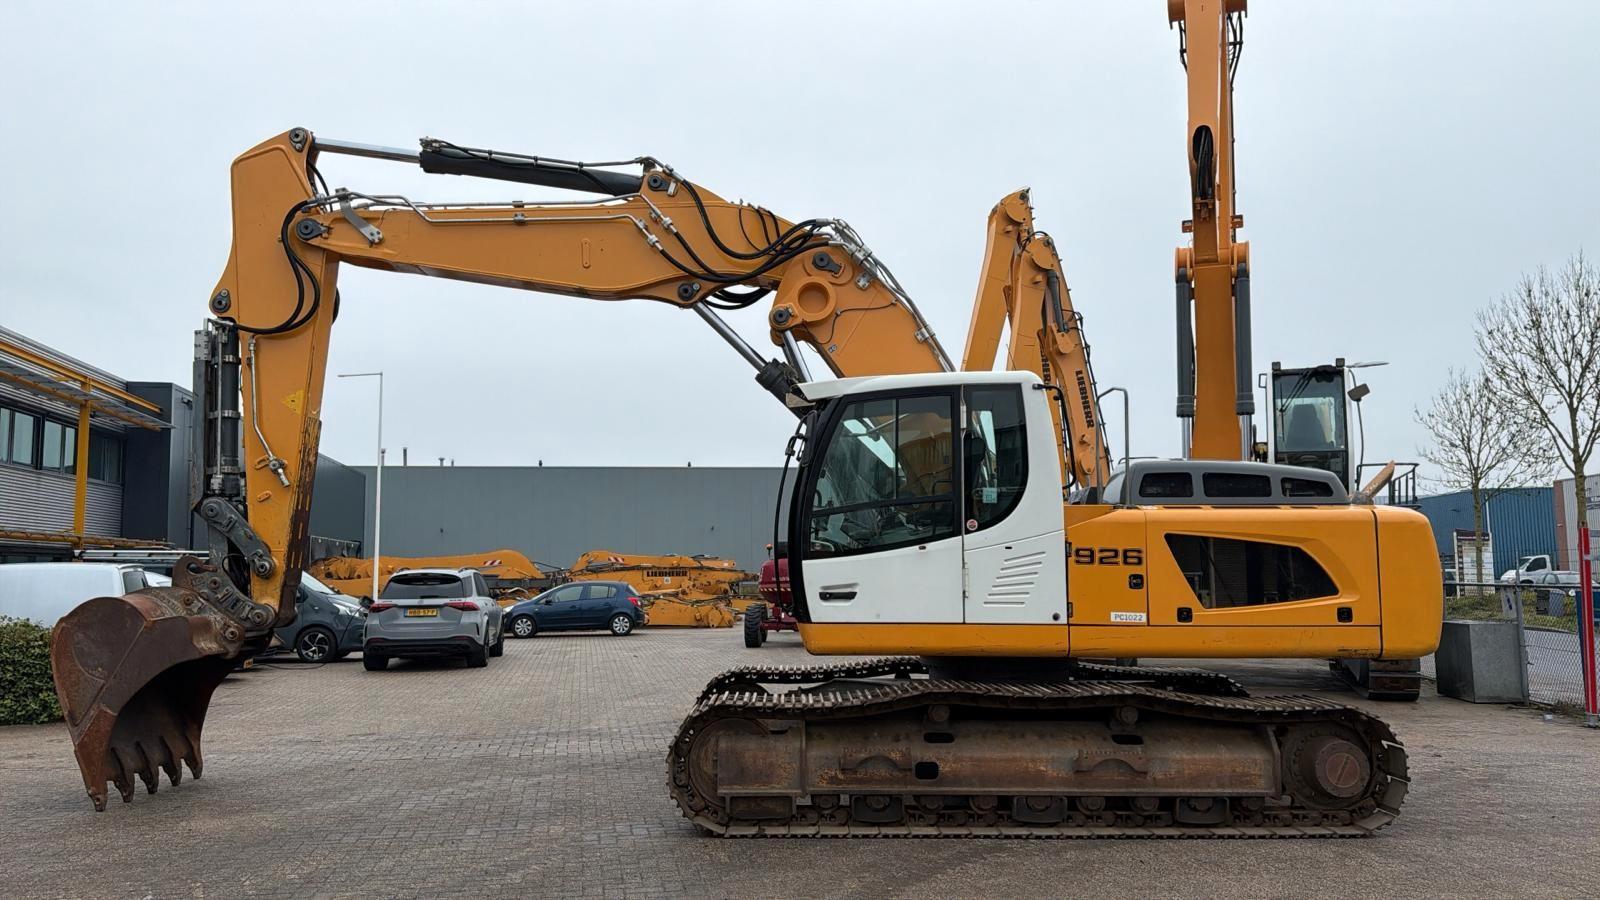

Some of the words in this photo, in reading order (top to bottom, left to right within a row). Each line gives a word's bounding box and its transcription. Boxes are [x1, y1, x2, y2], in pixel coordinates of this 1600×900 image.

[1075, 370, 1095, 429] LIEBHERR
[1075, 547, 1143, 565] 926
[1114, 613, 1143, 621] PC1022
